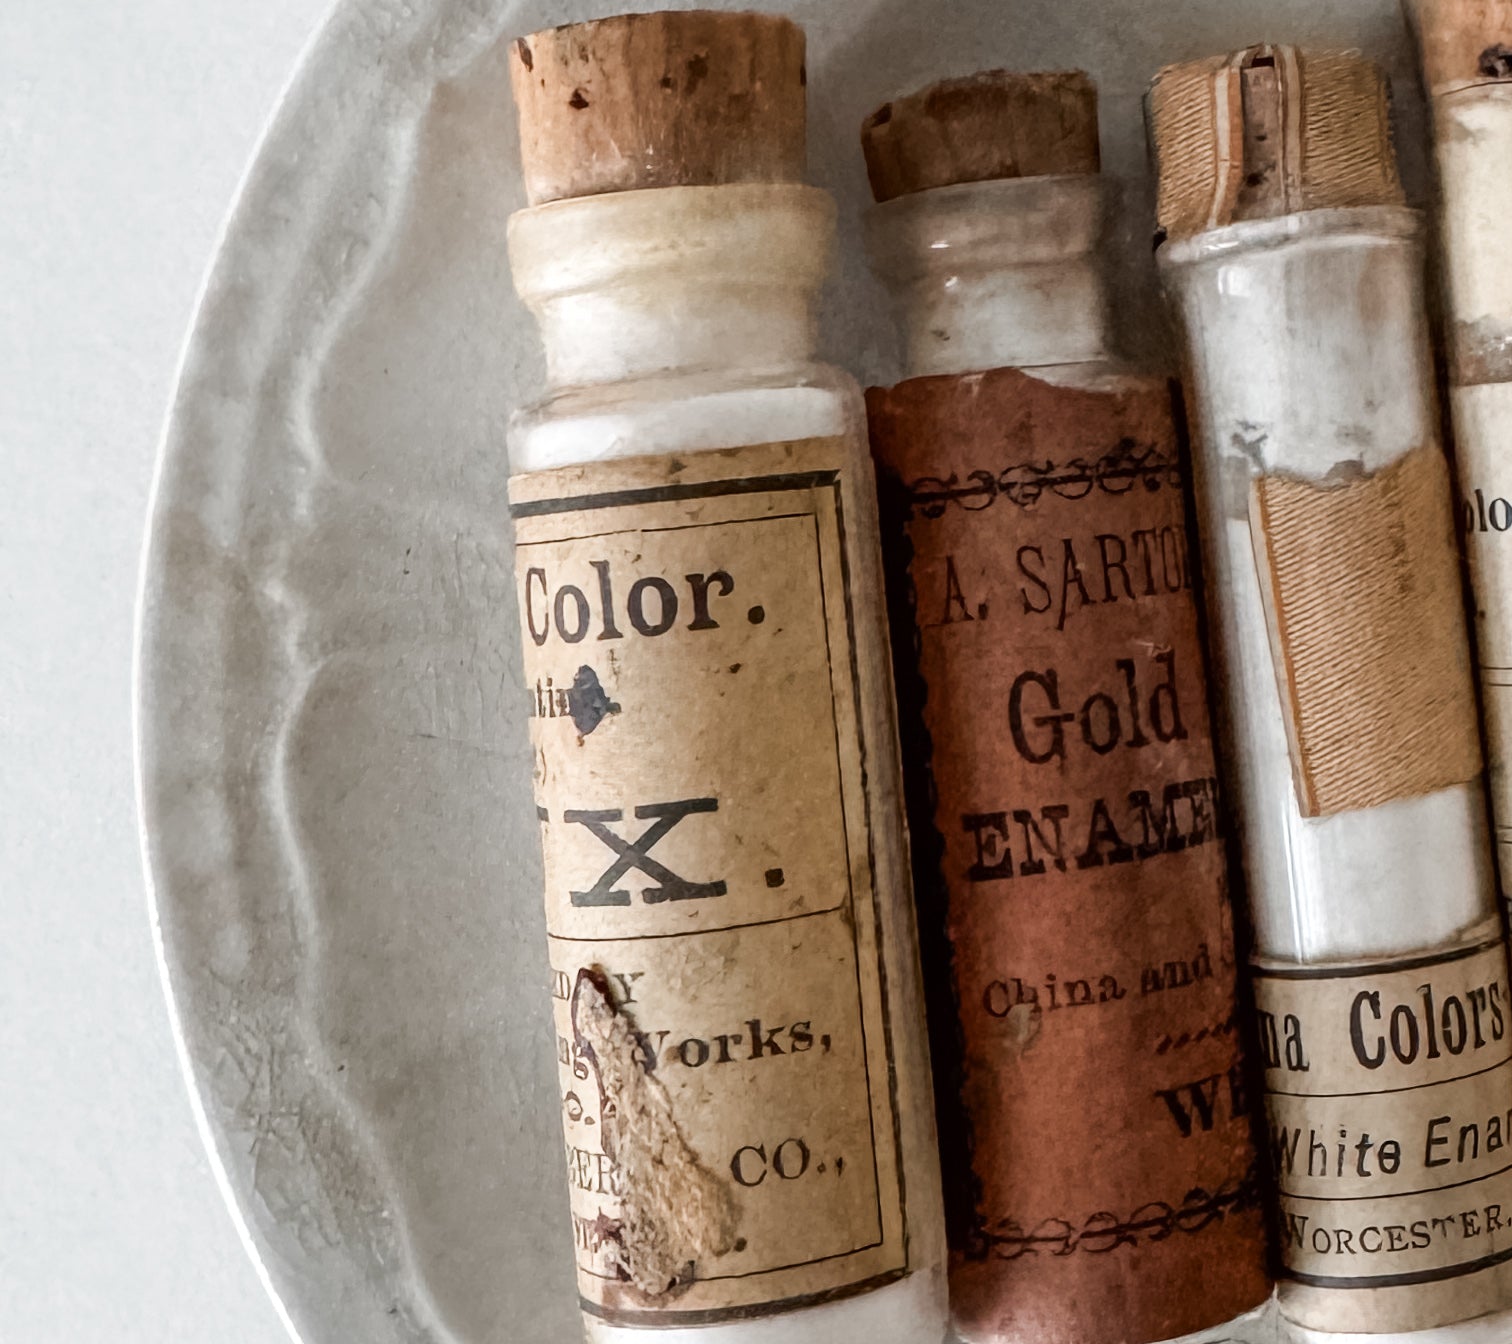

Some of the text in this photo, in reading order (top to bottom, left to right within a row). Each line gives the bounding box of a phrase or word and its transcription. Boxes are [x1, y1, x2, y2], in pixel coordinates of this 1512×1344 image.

[525, 559, 765, 646] Color.
[1009, 651, 1189, 766] Gold
[535, 797, 785, 908] X.
[983, 972, 1128, 1018] China
[1141, 944, 1213, 997] and
[1349, 980, 1505, 1070] Colors
[730, 1137, 845, 1187] CO.,
[1277, 1123, 1402, 1178] White
